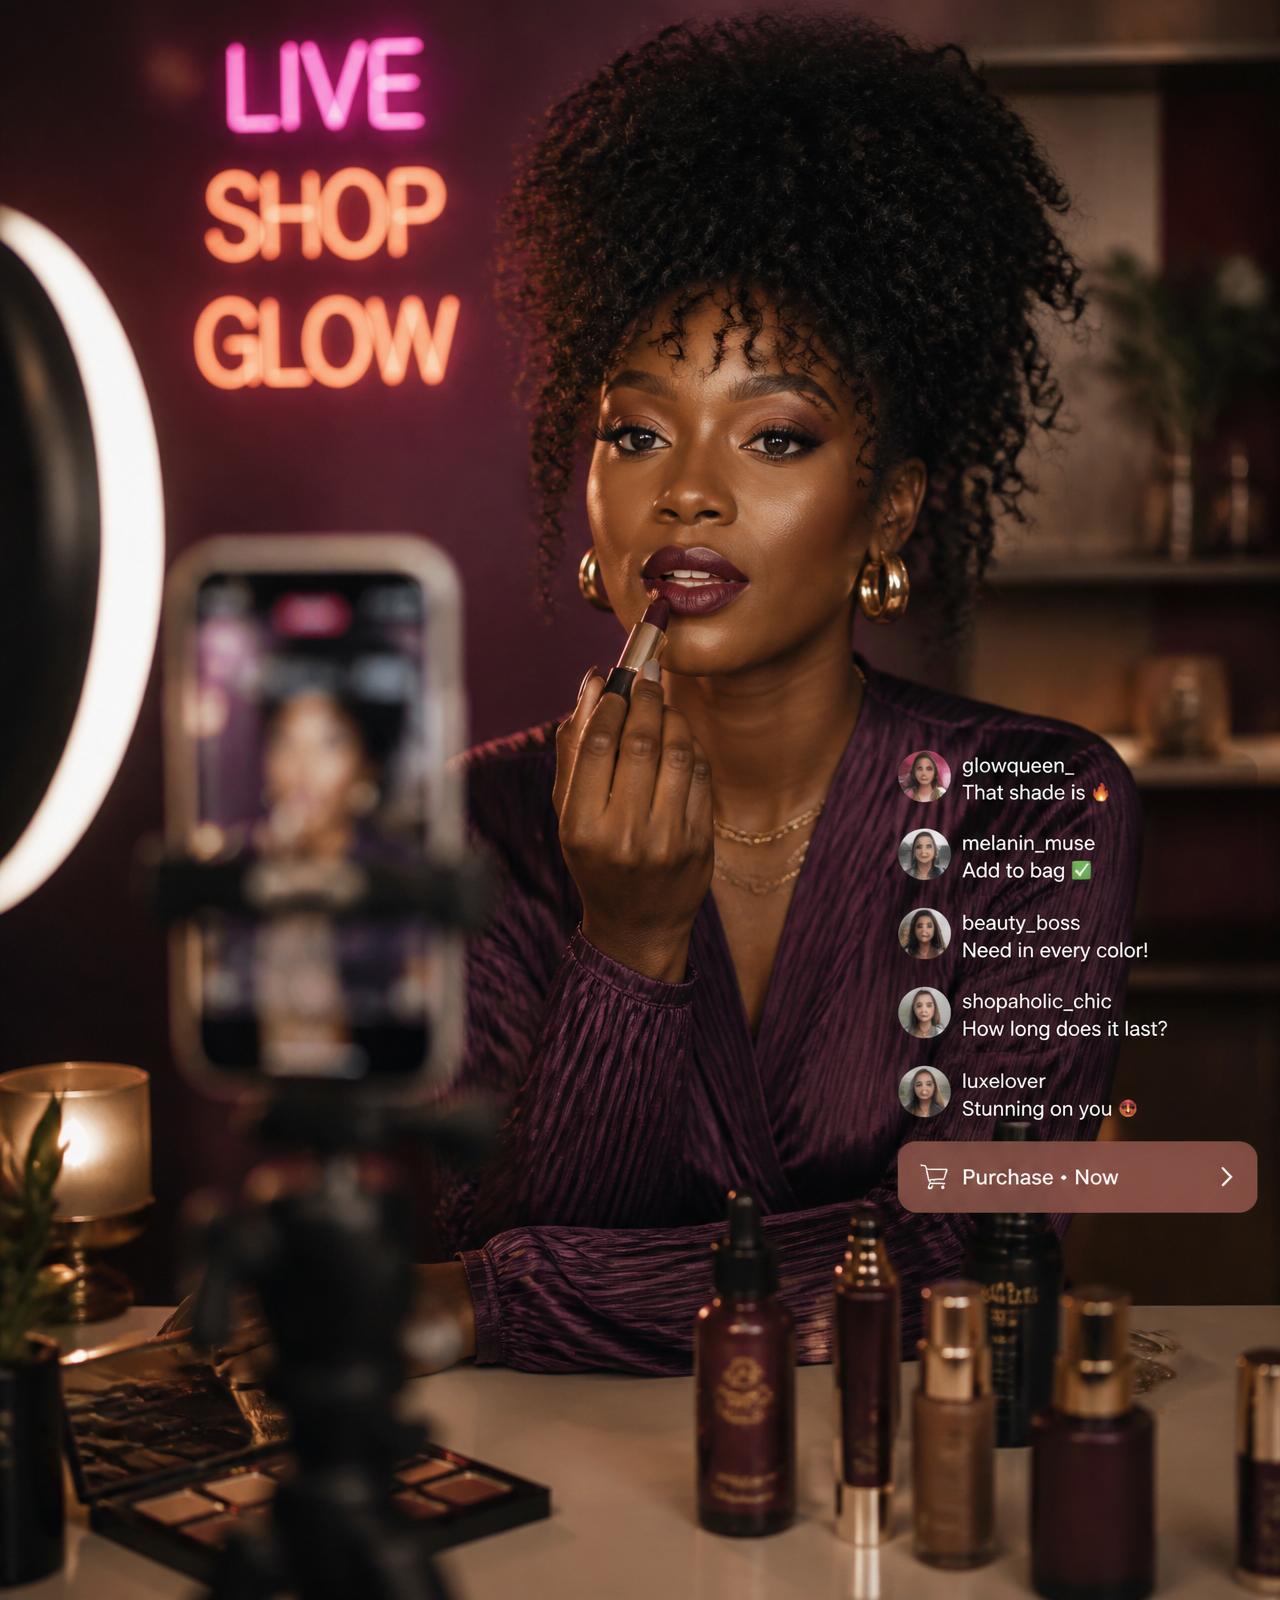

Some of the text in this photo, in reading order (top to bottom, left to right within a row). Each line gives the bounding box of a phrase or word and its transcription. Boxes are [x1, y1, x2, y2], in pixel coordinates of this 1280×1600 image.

[225, 36, 426, 134] LIVE
[203, 165, 448, 264] SHOP
[193, 293, 461, 391] GLOW
